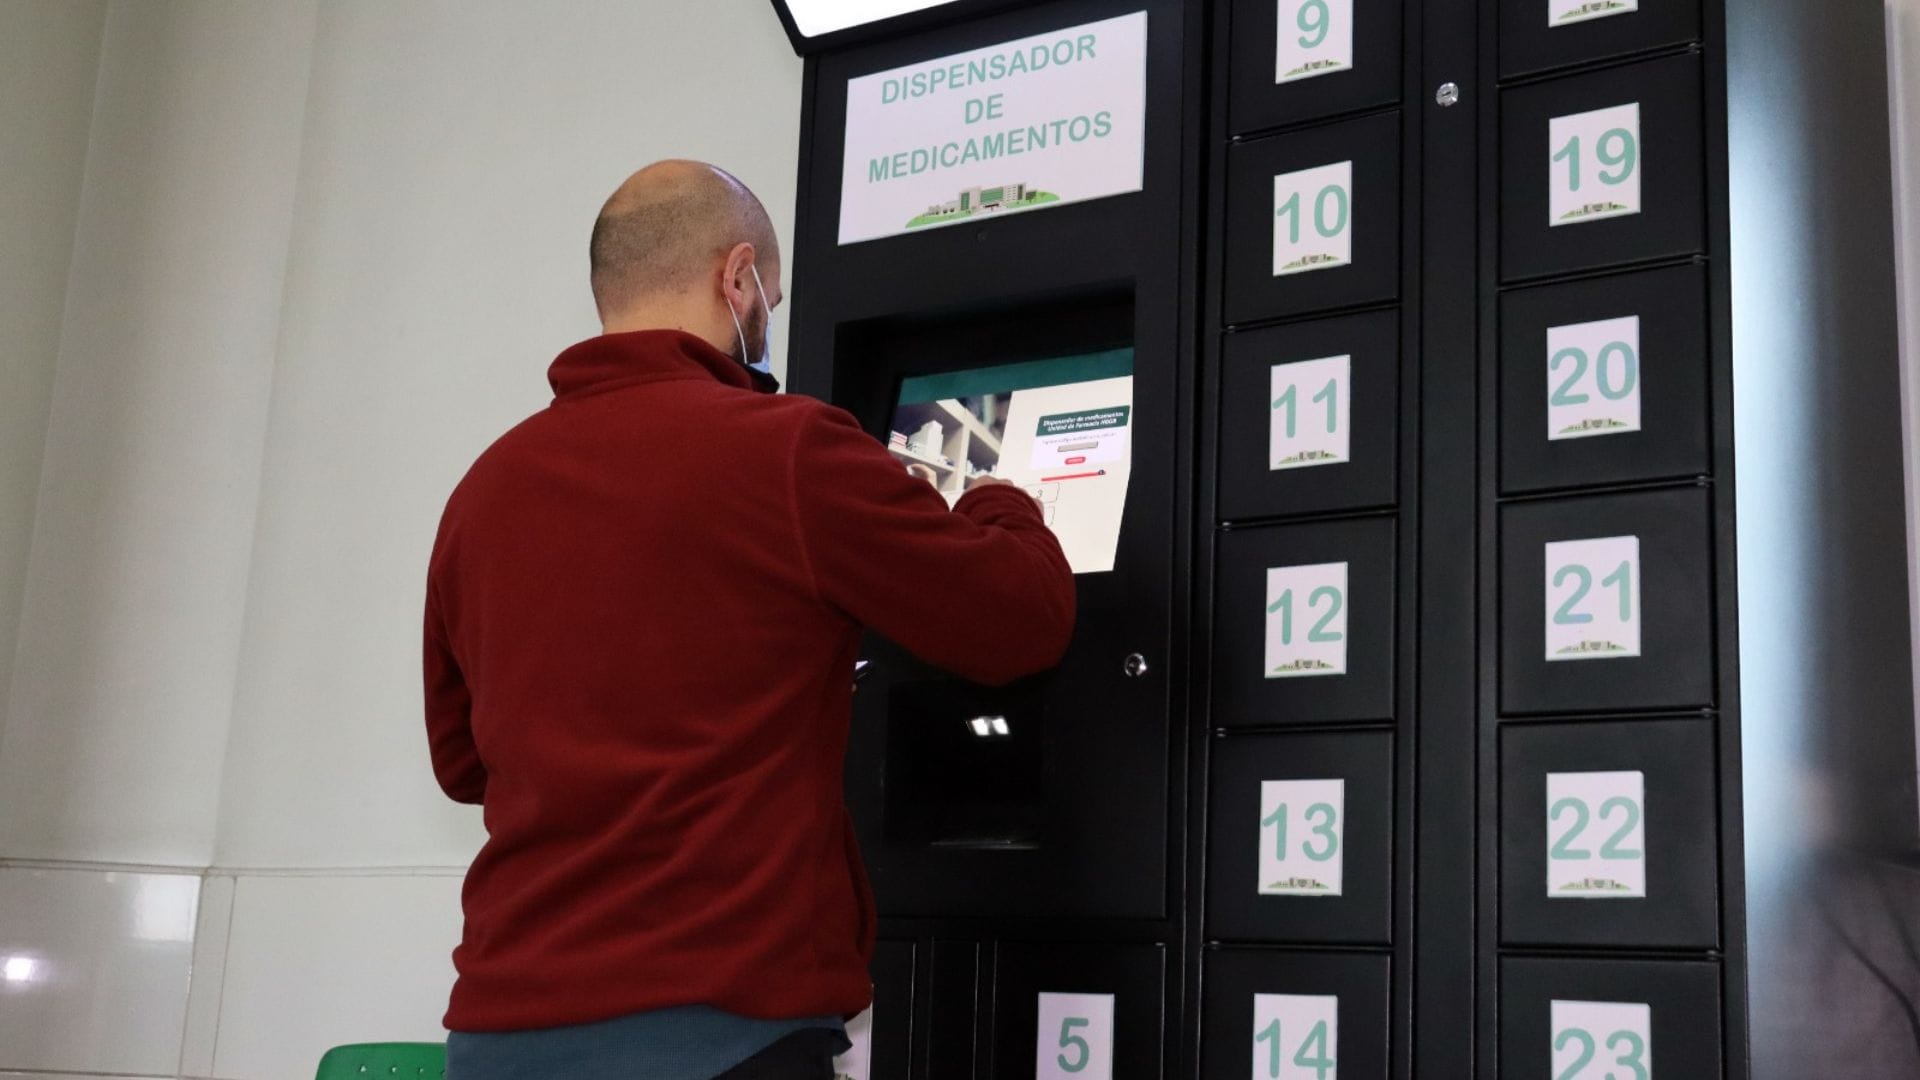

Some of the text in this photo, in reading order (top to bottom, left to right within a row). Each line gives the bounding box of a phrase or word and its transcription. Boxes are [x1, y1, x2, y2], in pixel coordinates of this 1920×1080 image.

[1296, 0, 1330, 49] 9
[881, 34, 1097, 105] DISPENSADOR
[964, 93, 1004, 125] DE
[868, 111, 1113, 183] MEDICAMENTOS
[1553, 127, 1637, 192] 19
[1276, 184, 1349, 244] 10
[1549, 341, 1638, 407] 20
[1272, 378, 1338, 438] 11
[1267, 585, 1343, 646] 12
[1552, 560, 1631, 625] 21
[1262, 802, 1339, 862] 13
[1550, 796, 1641, 861] 22
[1057, 1016, 1090, 1073] 5
[1255, 1018, 1335, 1080] 14
[1554, 1028, 1649, 1080] 23
